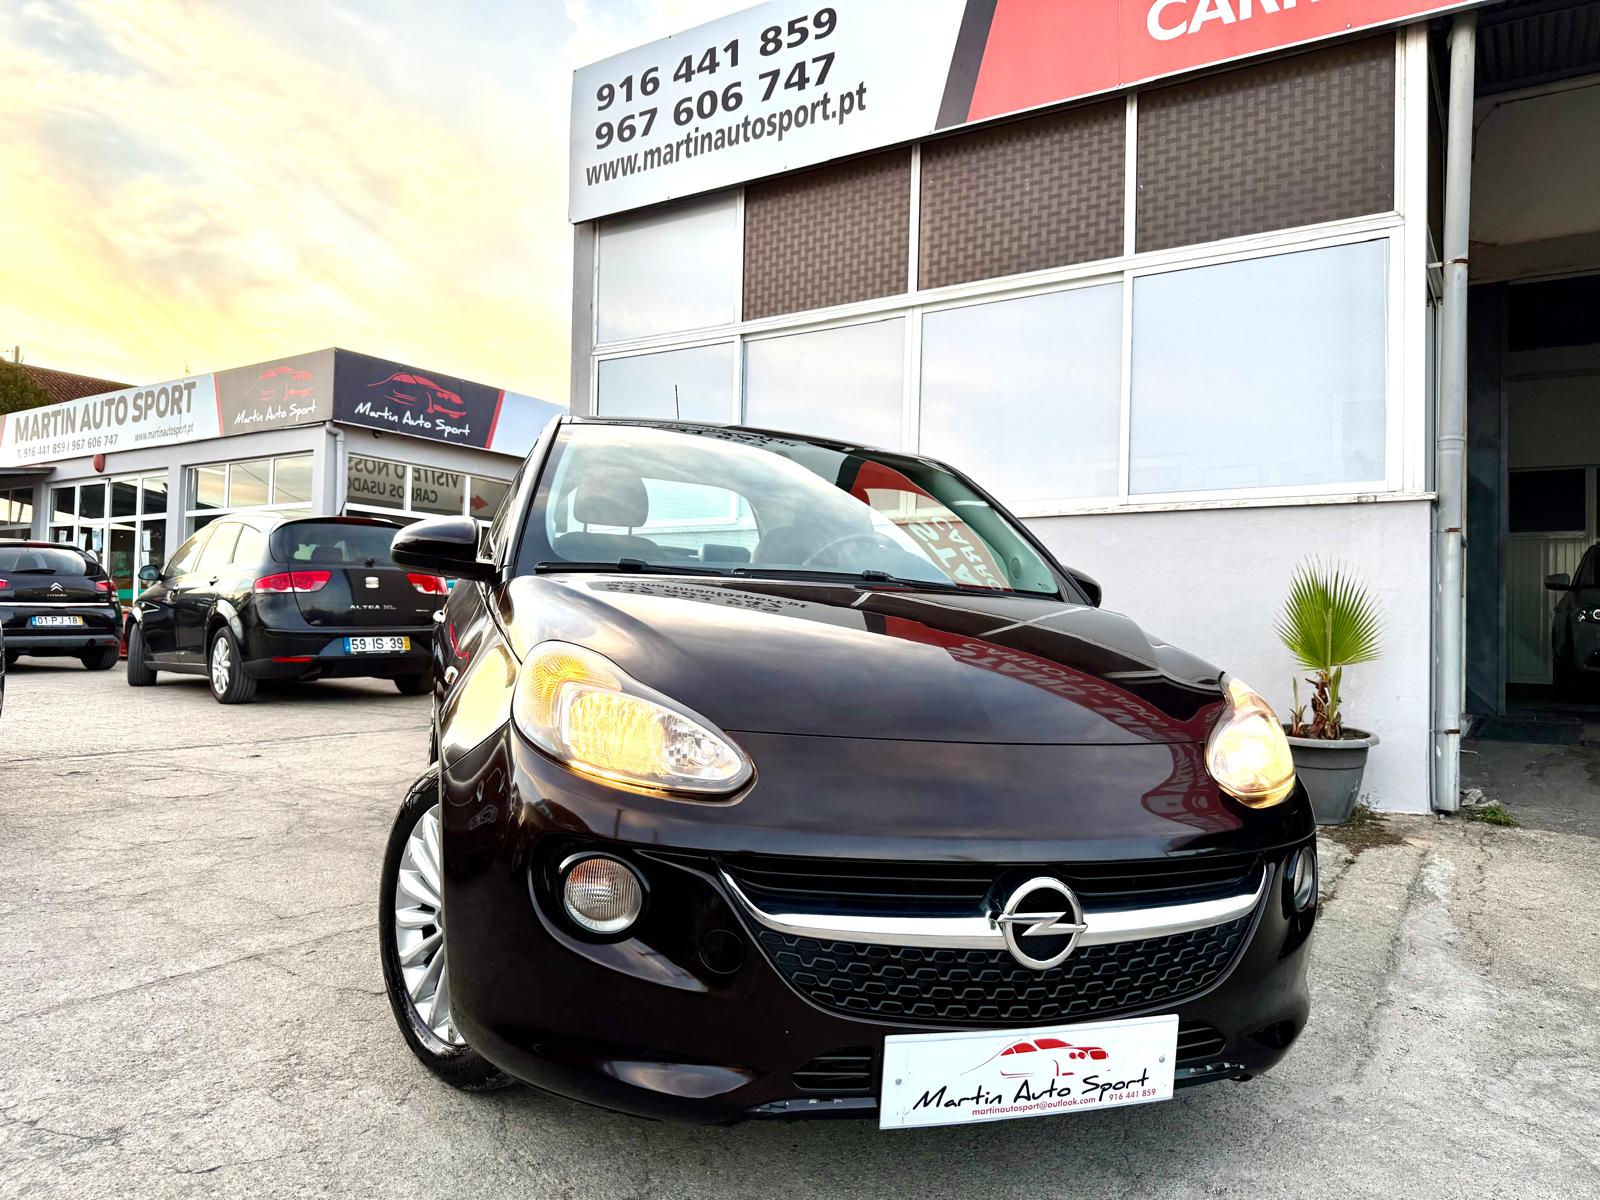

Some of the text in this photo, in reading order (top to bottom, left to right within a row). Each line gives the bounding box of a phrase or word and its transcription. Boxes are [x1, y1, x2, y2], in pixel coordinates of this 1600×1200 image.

[596, 7, 837, 111] 916 441 859
[595, 51, 836, 150] 967 606 747
[585, 81, 867, 188] www.martinautosport.pt
[15, 381, 197, 444] MARTIN AUTO SPORT
[234, 398, 316, 425] Martin Auto Sport
[354, 401, 470, 438] Martin Auto Sport
[38, 444, 50, 455] 441
[71, 438, 86, 451] 967
[87, 436, 102, 449] 606
[103, 433, 118, 446] 747
[134, 422, 194, 442] www.martinautosport.pt
[912, 1068, 1149, 1110] Martin Auto Sport
[972, 1088, 1157, 1116] martinautosport@outlook.com 916 441 859
